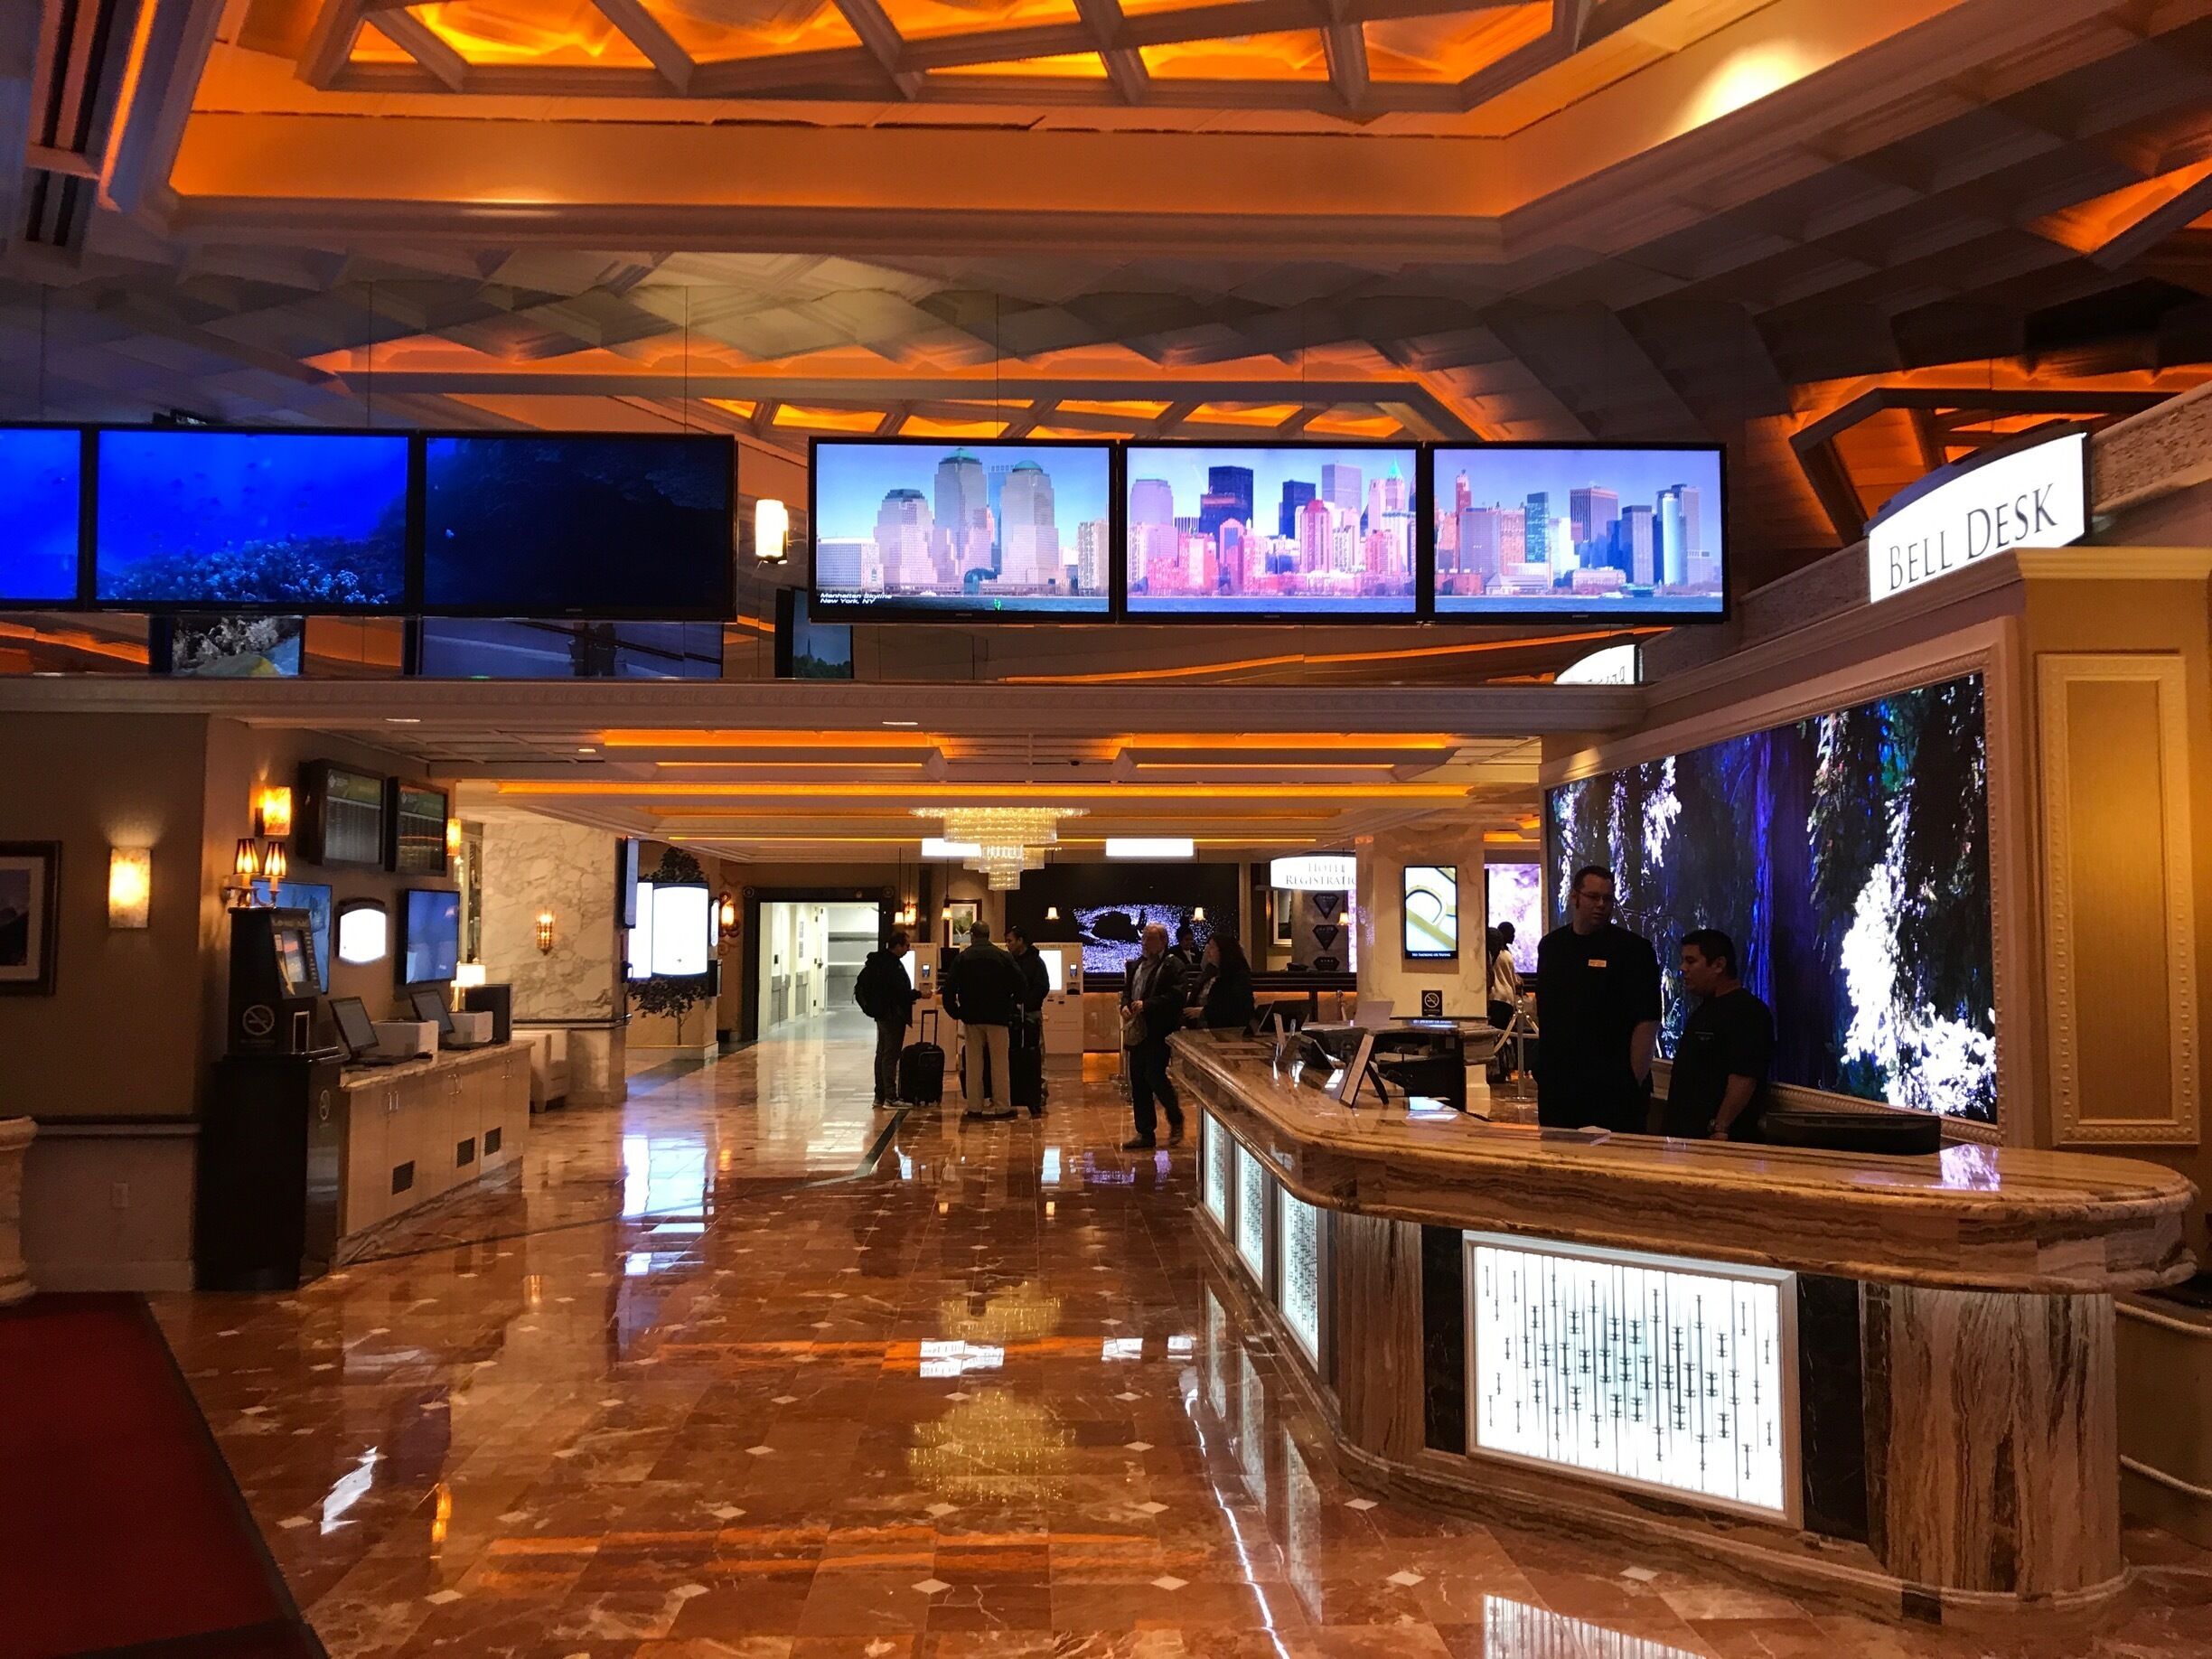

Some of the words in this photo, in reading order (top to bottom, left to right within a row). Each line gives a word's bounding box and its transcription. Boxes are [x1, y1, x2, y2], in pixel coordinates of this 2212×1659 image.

[1889, 545, 1953, 591] BELL
[1966, 483, 2058, 561] DESK
[863, 592, 893, 600] Skyline
[1308, 862, 1345, 873] HOTEL
